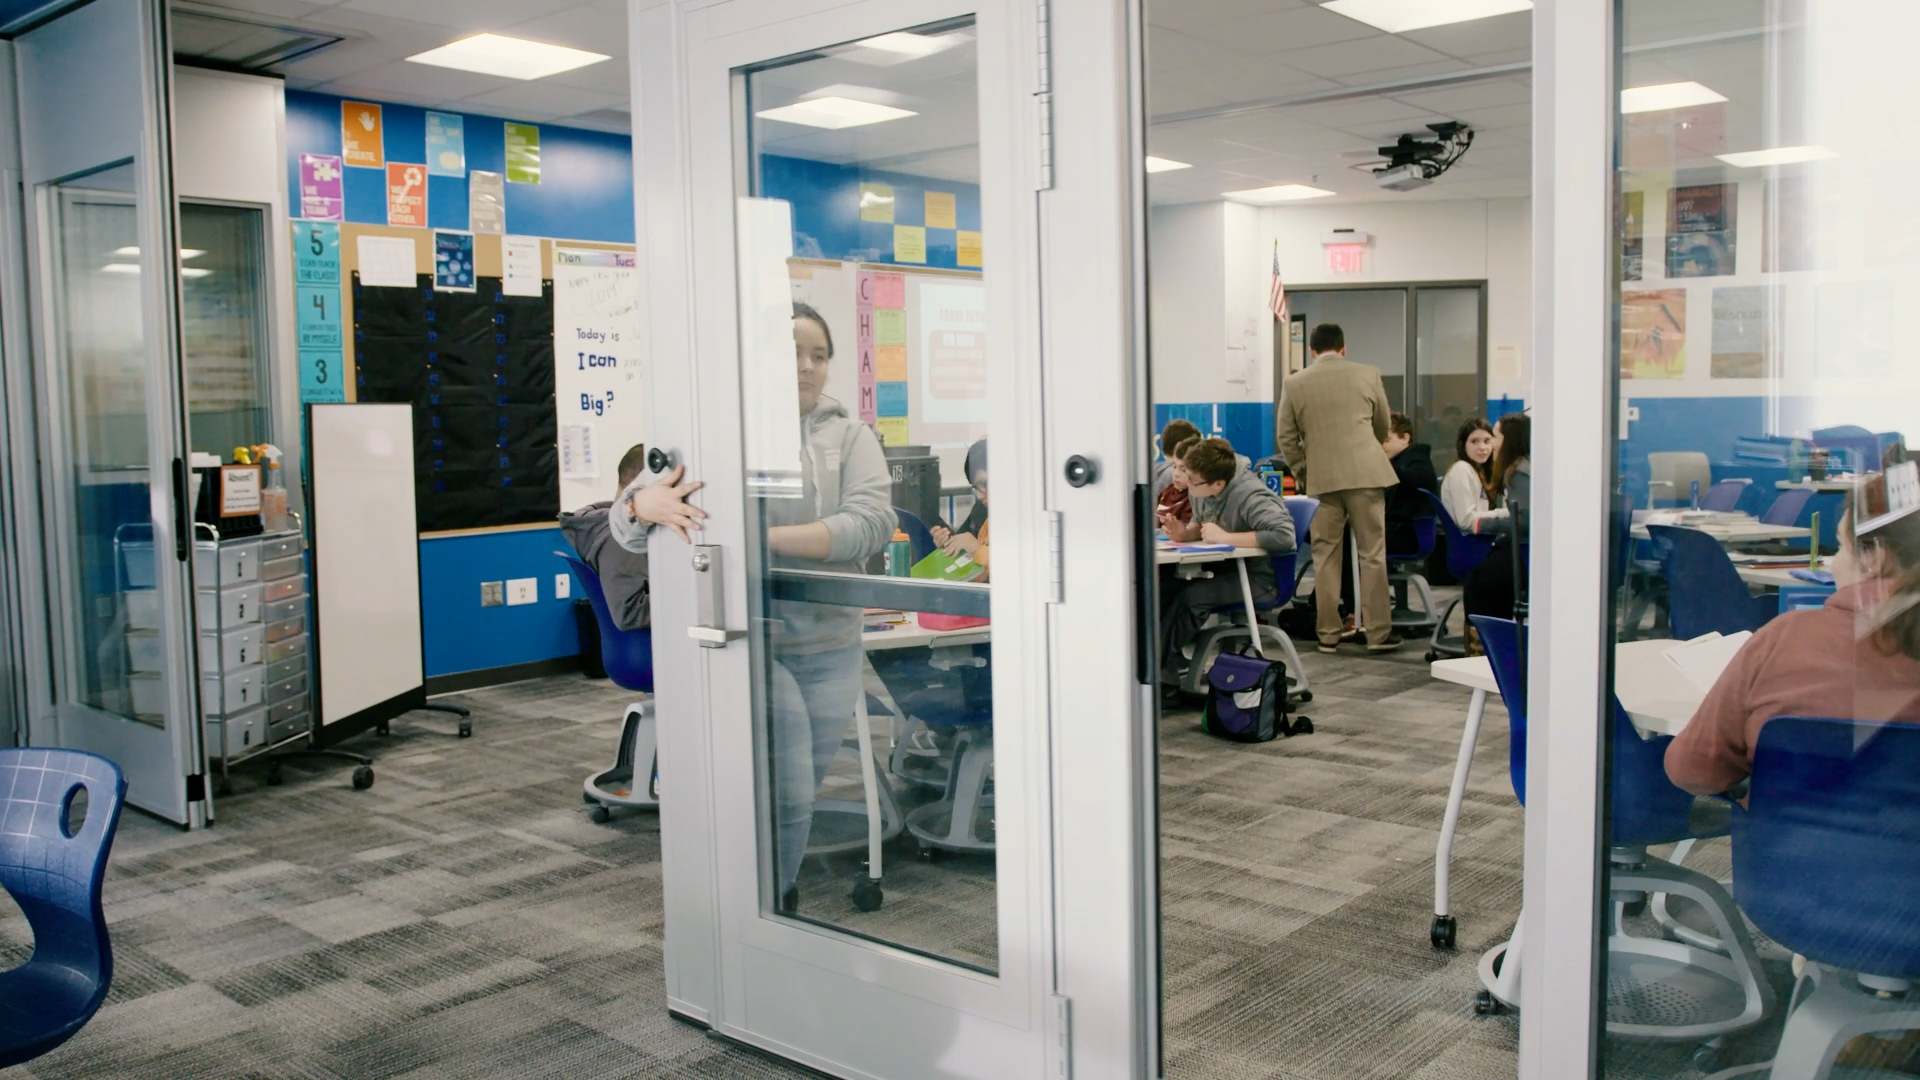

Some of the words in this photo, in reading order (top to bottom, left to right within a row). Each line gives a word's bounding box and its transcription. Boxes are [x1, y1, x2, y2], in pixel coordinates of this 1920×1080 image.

[310, 230, 324, 256] 5
[558, 252, 581, 263] Mon
[614, 254, 635, 268] Tues
[313, 295, 325, 320] 4
[576, 328, 606, 343] Today
[611, 326, 620, 342] is
[577, 352, 585, 370] I
[315, 359, 327, 384] 3
[893, 466, 902, 481] 16
